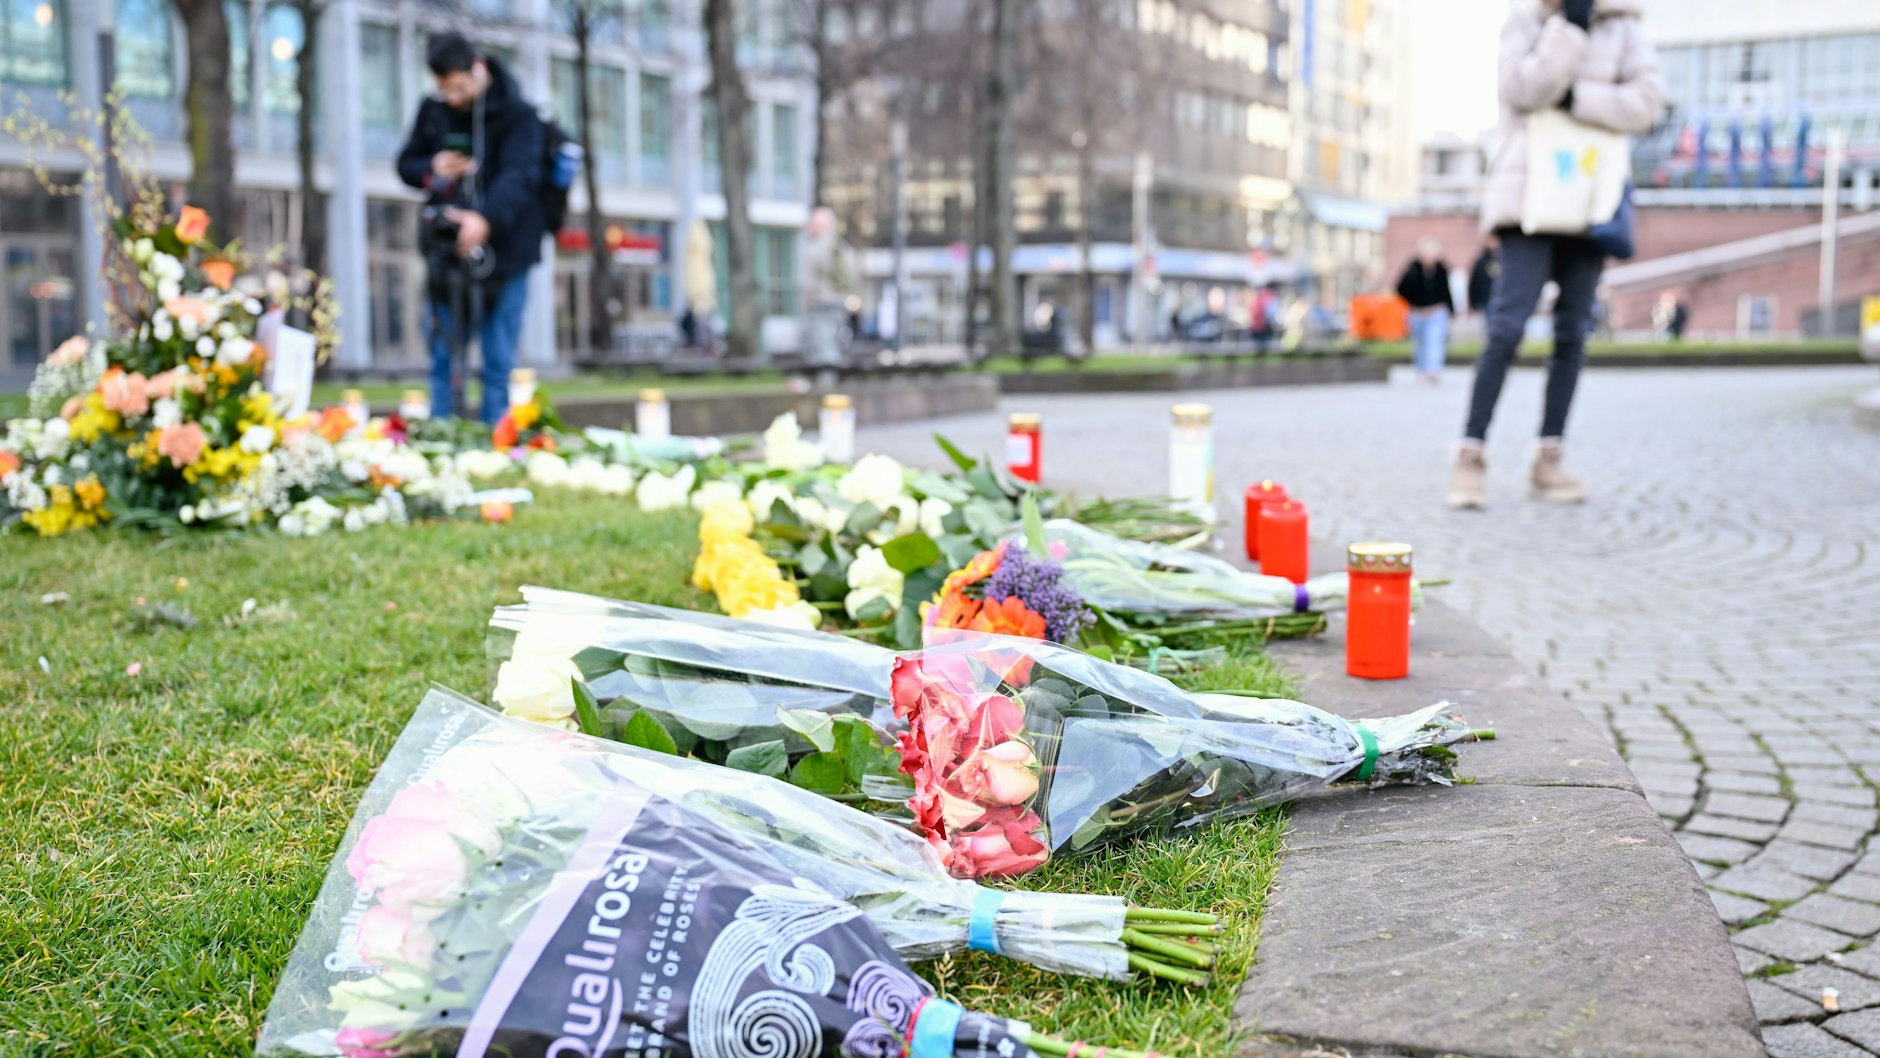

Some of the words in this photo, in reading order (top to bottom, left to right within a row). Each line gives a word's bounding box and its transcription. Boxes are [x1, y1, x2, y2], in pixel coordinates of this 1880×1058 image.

[646, 865, 688, 964] CELEBRITY
[672, 883, 701, 943] ROSES
[663, 950, 682, 977] OF
[634, 972, 656, 1014] THE
[624, 1022, 646, 1058] EET
[645, 986, 673, 1058] BRAND
